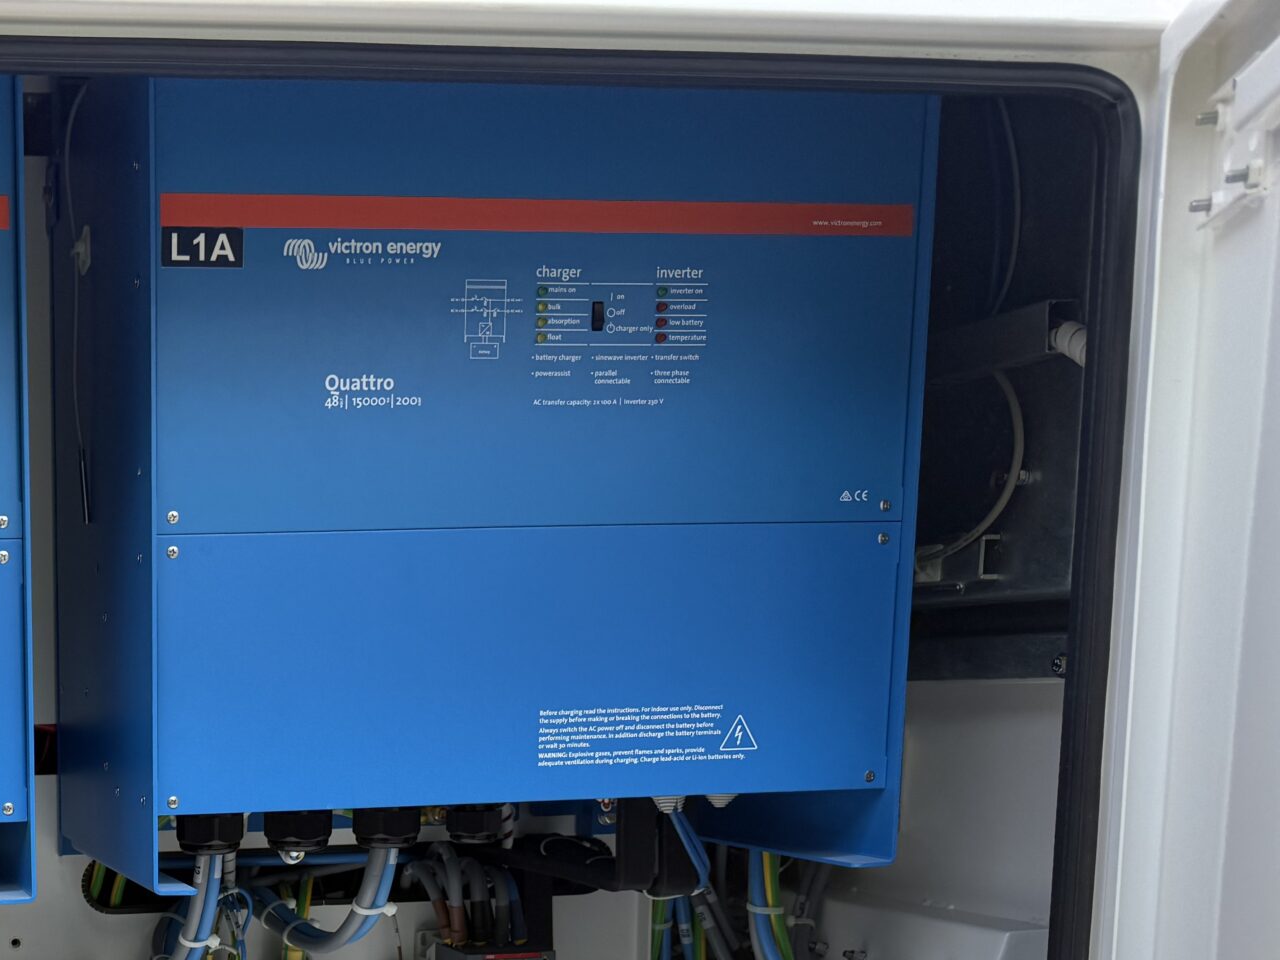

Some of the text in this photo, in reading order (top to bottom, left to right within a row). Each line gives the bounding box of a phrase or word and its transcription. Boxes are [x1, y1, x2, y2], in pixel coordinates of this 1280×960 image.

[171, 232, 235, 261] L1A
[329, 238, 441, 258] victron energy
[536, 264, 581, 281] charger
[656, 266, 703, 278] inverter
[547, 317, 580, 325] absorption
[681, 319, 703, 327] battery
[614, 325, 638, 333] charger
[535, 353, 581, 362] battery charger
[594, 369, 617, 377] parallel
[671, 369, 689, 378] phase
[325, 374, 394, 395] Quattro
